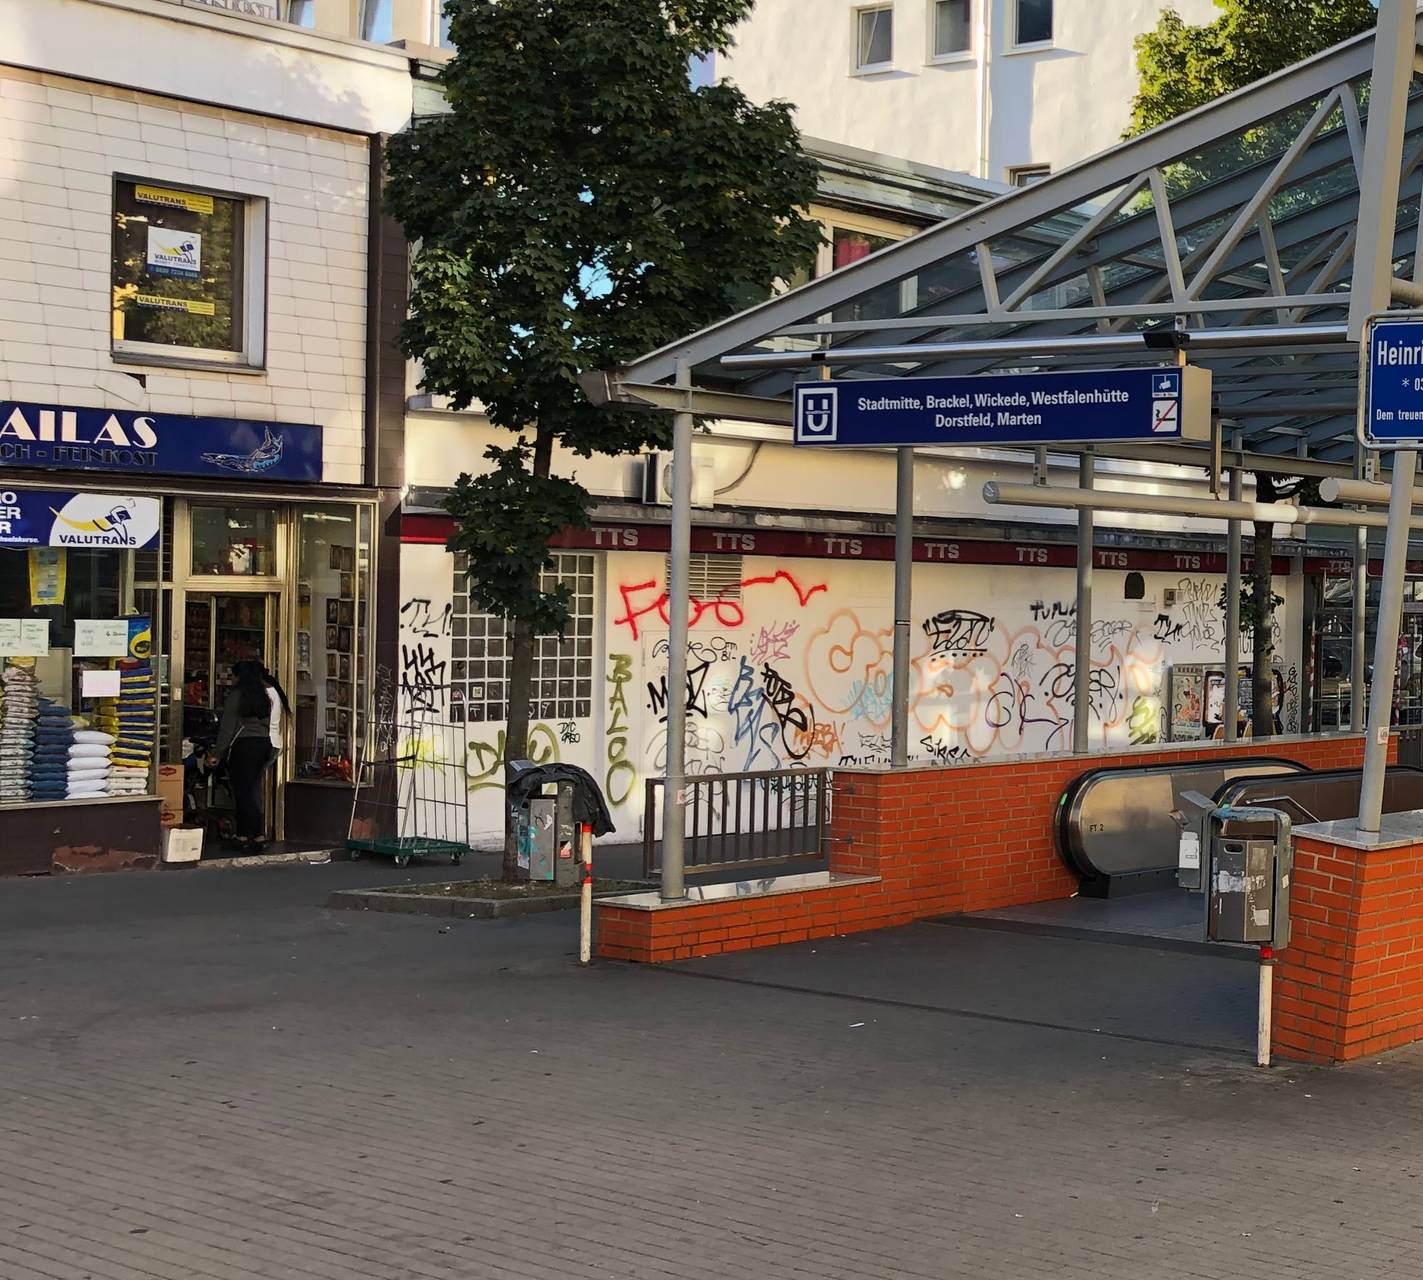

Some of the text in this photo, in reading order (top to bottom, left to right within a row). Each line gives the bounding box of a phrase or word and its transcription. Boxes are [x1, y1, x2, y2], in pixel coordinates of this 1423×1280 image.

[138, 192, 187, 205] VALUTRANS
[154, 253, 197, 265] VALUTRANS
[139, 296, 188, 307] VALUTRANS
[858, 389, 1129, 411] Stadtmitte, Brackel, Wickede, Westfalenhütte
[936, 412, 1042, 428] Dorstfeld, Marten
[1376, 409, 1394, 421] Dem
[1398, 409, 1423, 420] treuen
[53, 446, 158, 467] FEINKOST
[59, 534, 136, 545] VALUTRANS
[592, 528, 638, 546] TTS
[713, 533, 755, 551] TTS
[824, 538, 862, 555] TTS
[925, 543, 960, 559] TTS
[1016, 547, 1048, 563] TTS
[1099, 552, 1128, 566] TTS
[1174, 555, 1200, 569] TTS
